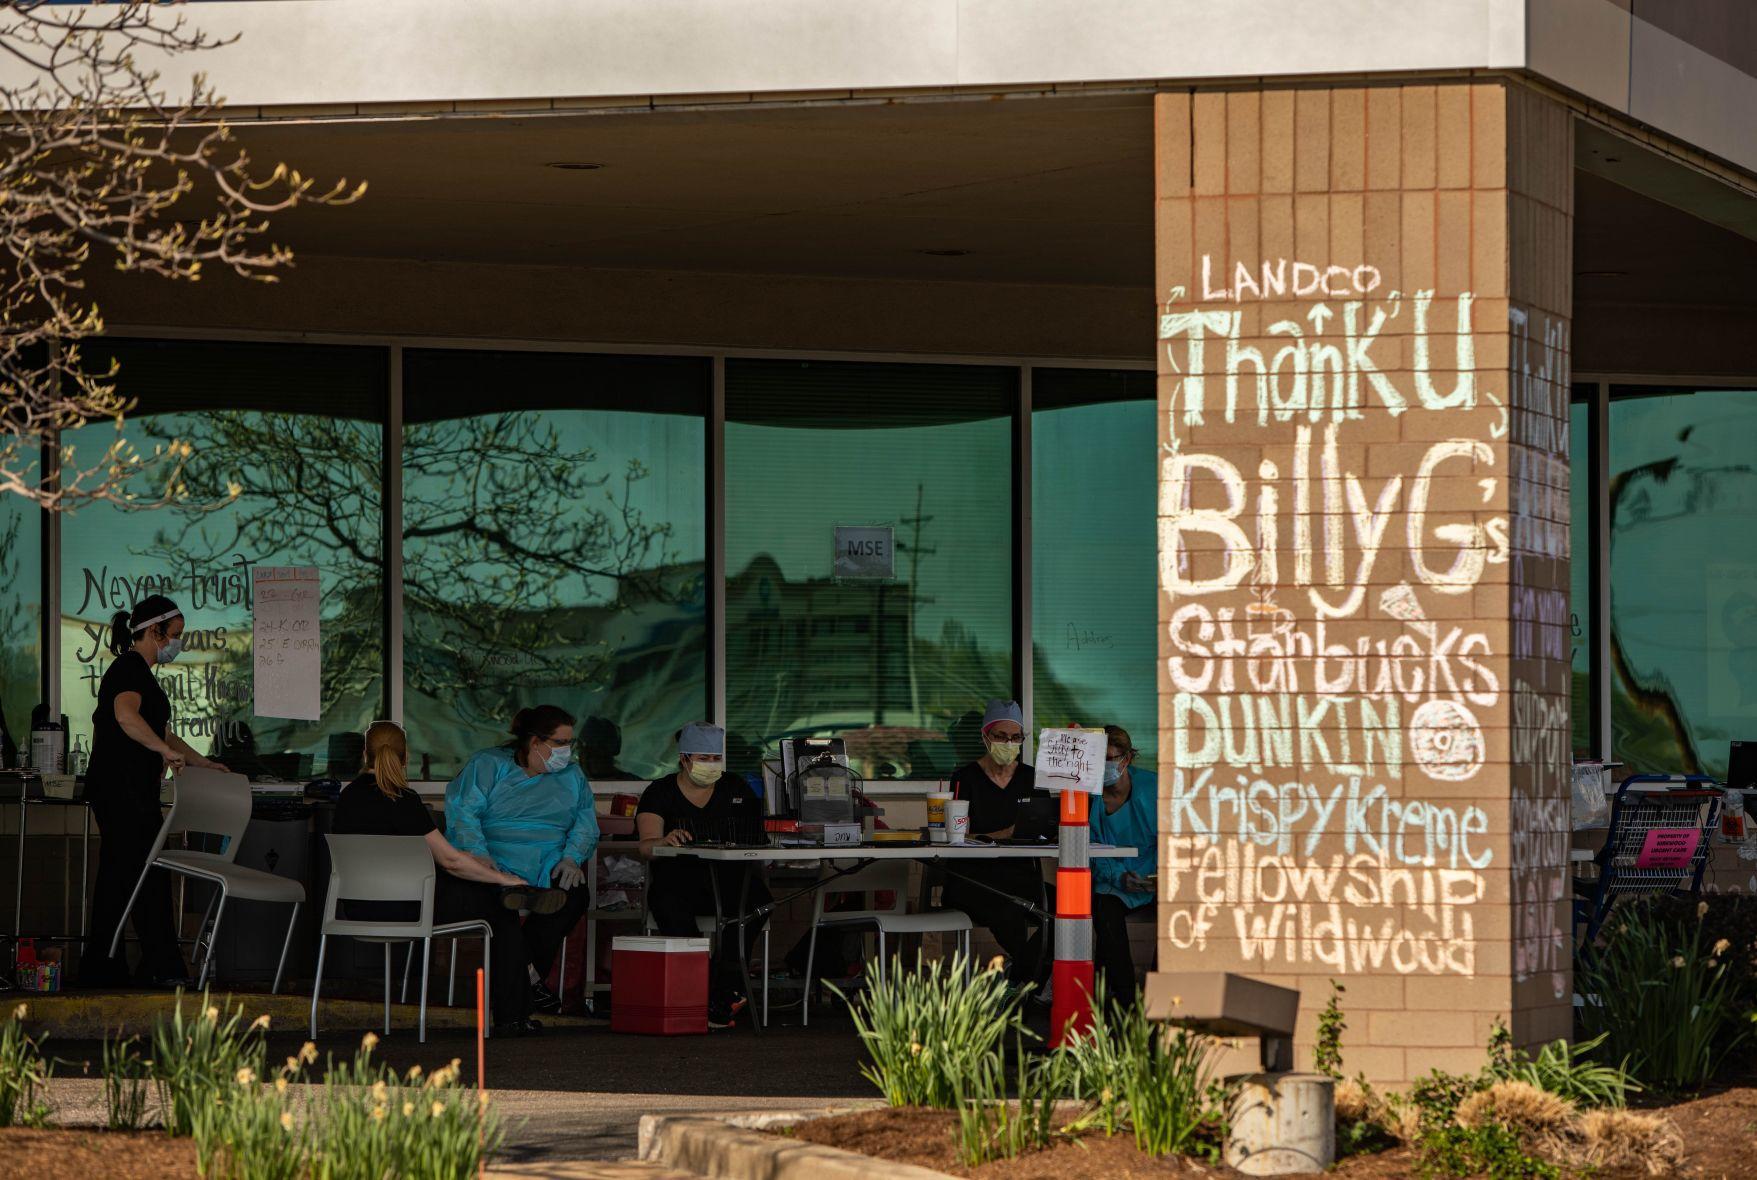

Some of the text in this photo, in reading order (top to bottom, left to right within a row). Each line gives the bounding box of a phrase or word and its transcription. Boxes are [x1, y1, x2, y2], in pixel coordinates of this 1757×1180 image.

[1413, 290, 1477, 411] U
[76, 553, 257, 615] Never trust
[847, 540, 884, 556] MSE
[1047, 756, 1091, 777] the right
[1071, 745, 1085, 760] to
[1172, 692, 1402, 779] DUNKIN
[1170, 767, 1344, 856] Krispy
[1344, 776, 1494, 869] Kreme
[1166, 833, 1486, 940] Fellowship
[1168, 903, 1476, 980] of Wildwood
